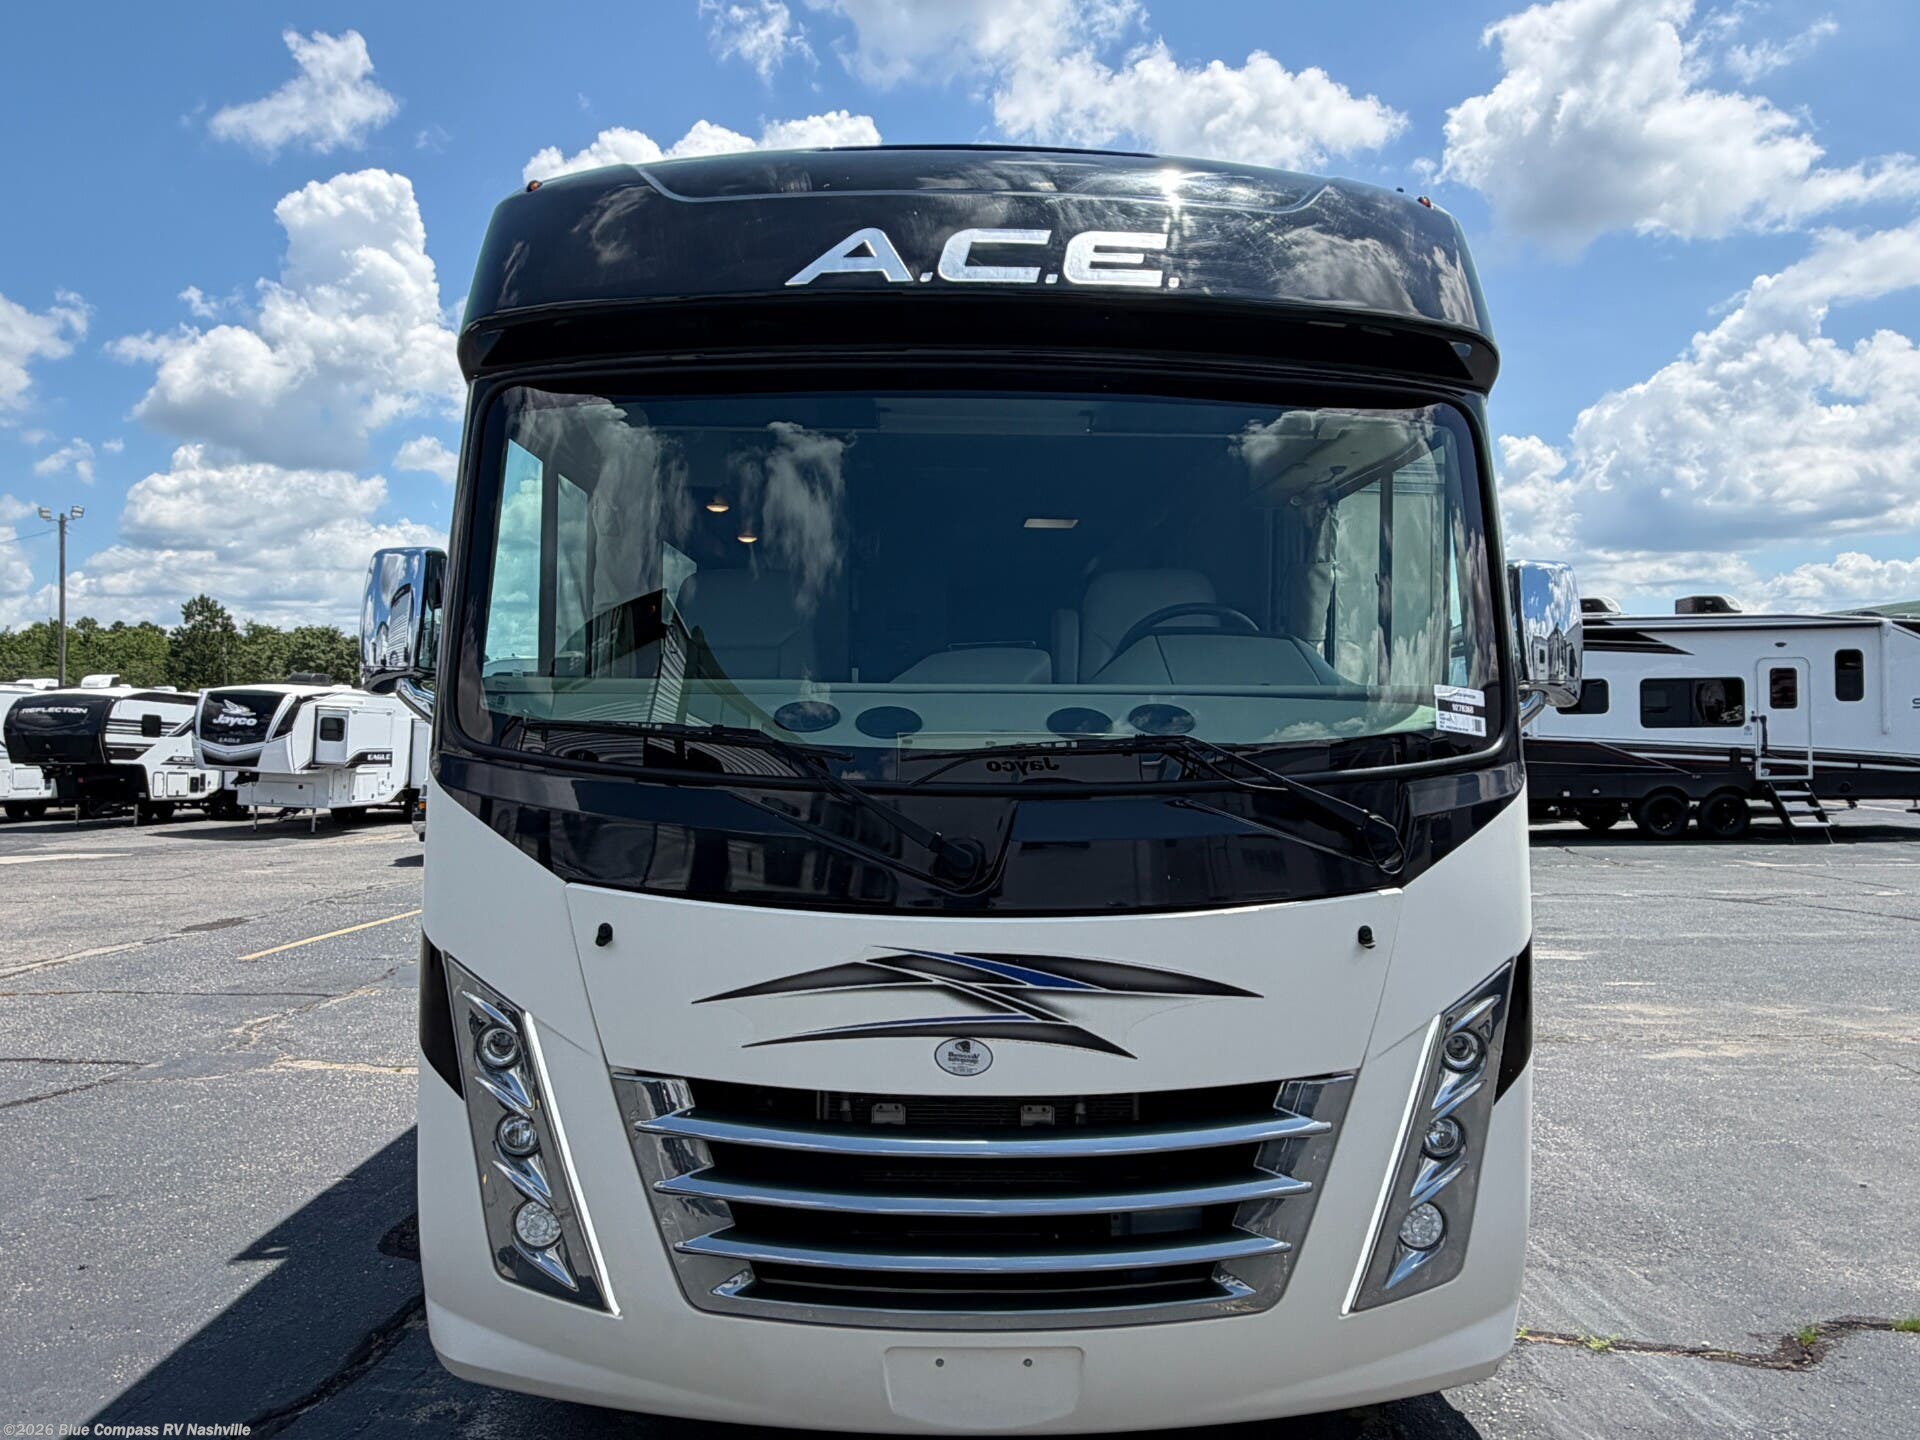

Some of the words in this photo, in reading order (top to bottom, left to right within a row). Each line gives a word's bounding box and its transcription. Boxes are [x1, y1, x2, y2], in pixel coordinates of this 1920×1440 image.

[784, 226, 1181, 289] A.C.E.
[22, 706, 88, 714] REFLECTION
[212, 714, 258, 727] Jayco
[367, 753, 392, 761] EAGLE
